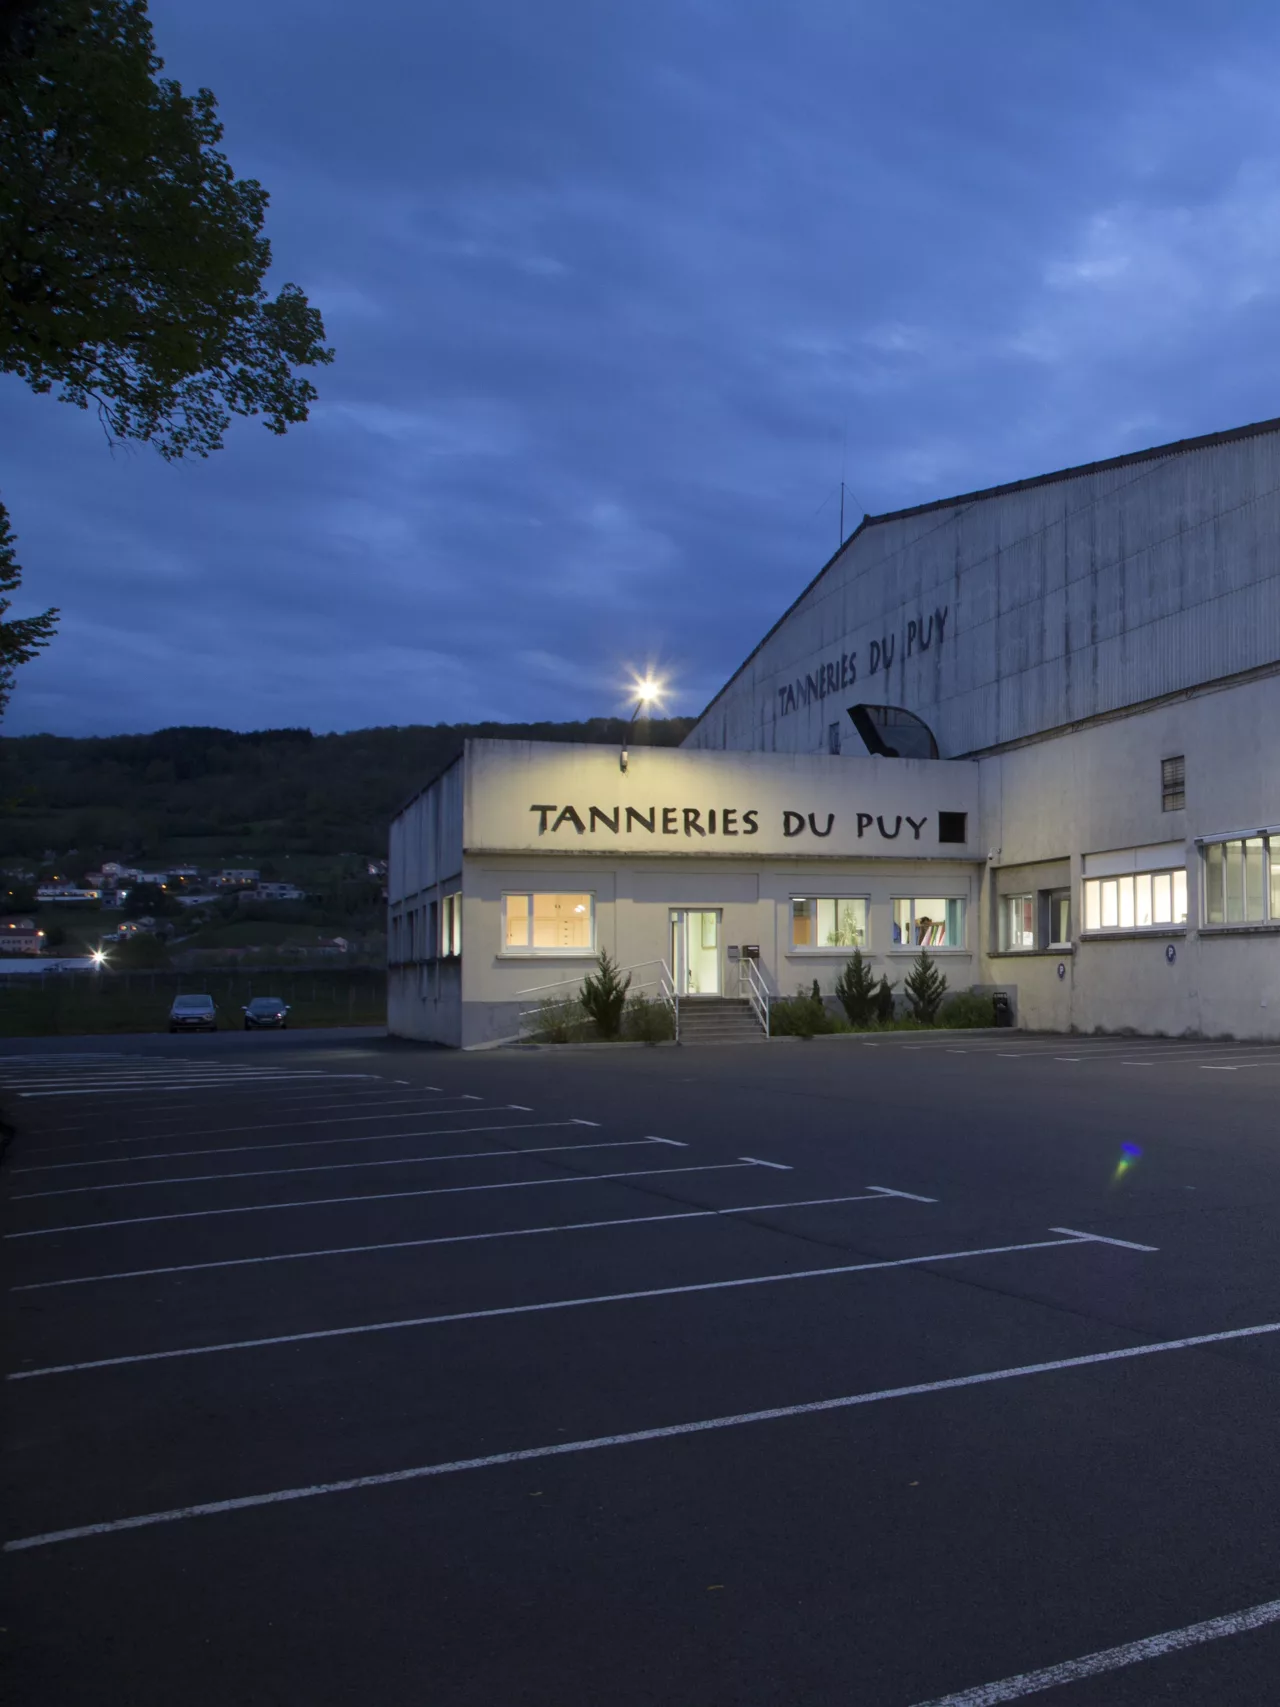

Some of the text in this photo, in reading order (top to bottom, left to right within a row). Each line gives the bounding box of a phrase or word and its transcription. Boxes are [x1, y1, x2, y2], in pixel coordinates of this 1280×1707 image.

[779, 606, 948, 716] TANNERIES DU PUY
[530, 805, 928, 840] TANNERIES DU PUY
